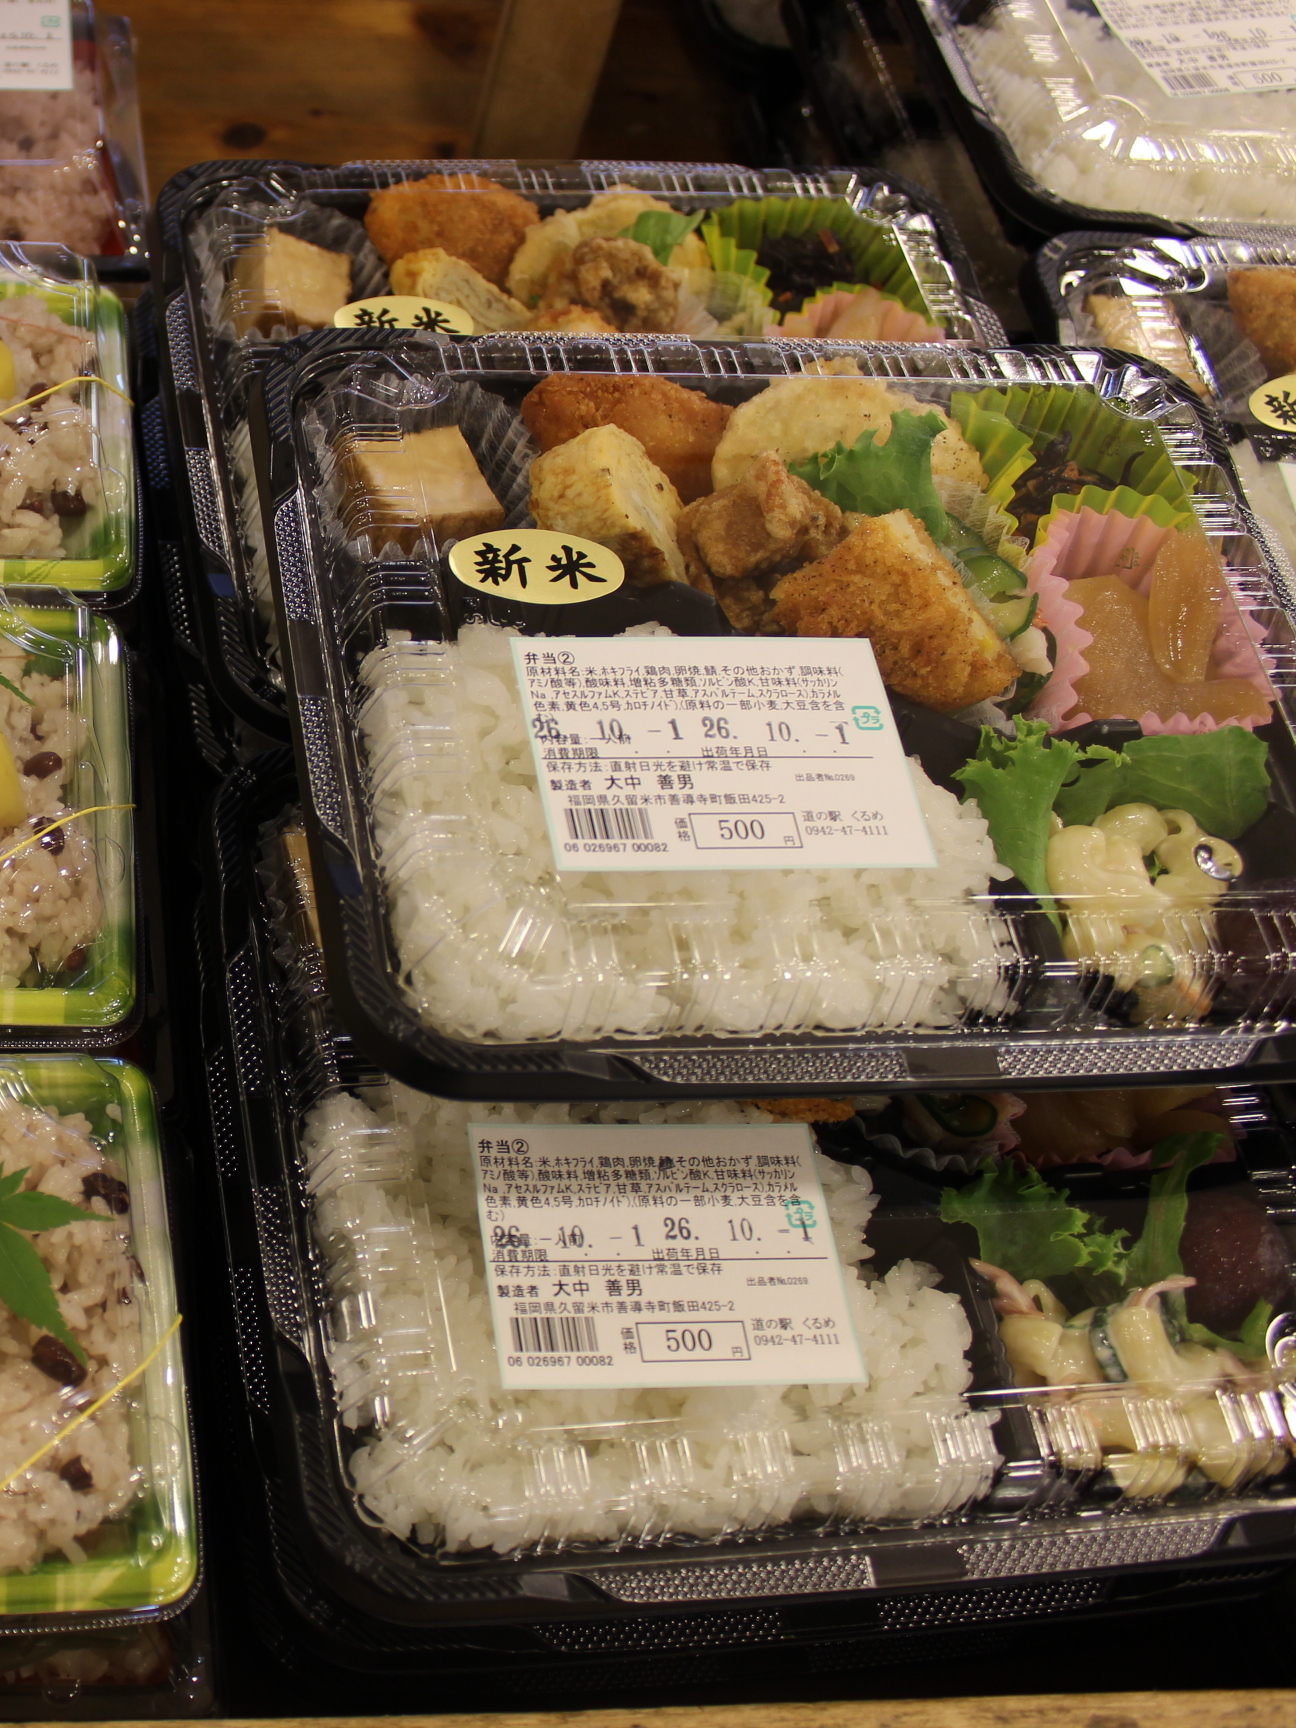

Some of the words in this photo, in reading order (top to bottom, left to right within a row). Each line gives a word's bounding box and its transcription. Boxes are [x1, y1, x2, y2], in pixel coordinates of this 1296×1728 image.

[1253, 72, 1283, 85] 500
[474, 542, 607, 589] 新米
[550, 778, 592, 791] 製造者
[604, 775, 642, 790] 大中
[656, 774, 694, 790] 善男
[802, 810, 843, 823] 道の駅
[853, 810, 884, 822] くるめ
[718, 819, 765, 841] 500
[806, 825, 889, 837] 0942-47-4111
[564, 843, 579, 852] 06
[584, 843, 627, 853] 026967
[632, 843, 668, 852] 00082
[498, 1285, 539, 1298] 製造者
[553, 1279, 590, 1297] 大中
[605, 1279, 643, 1297] 善男
[752, 1319, 795, 1331] 道の駅
[803, 1318, 836, 1330] くるめ
[666, 1329, 713, 1353] 500
[754, 1334, 840, 1346] 0942-47-4111
[527, 1356, 570, 1367] 026967
[576, 1356, 613, 1367] 00082
